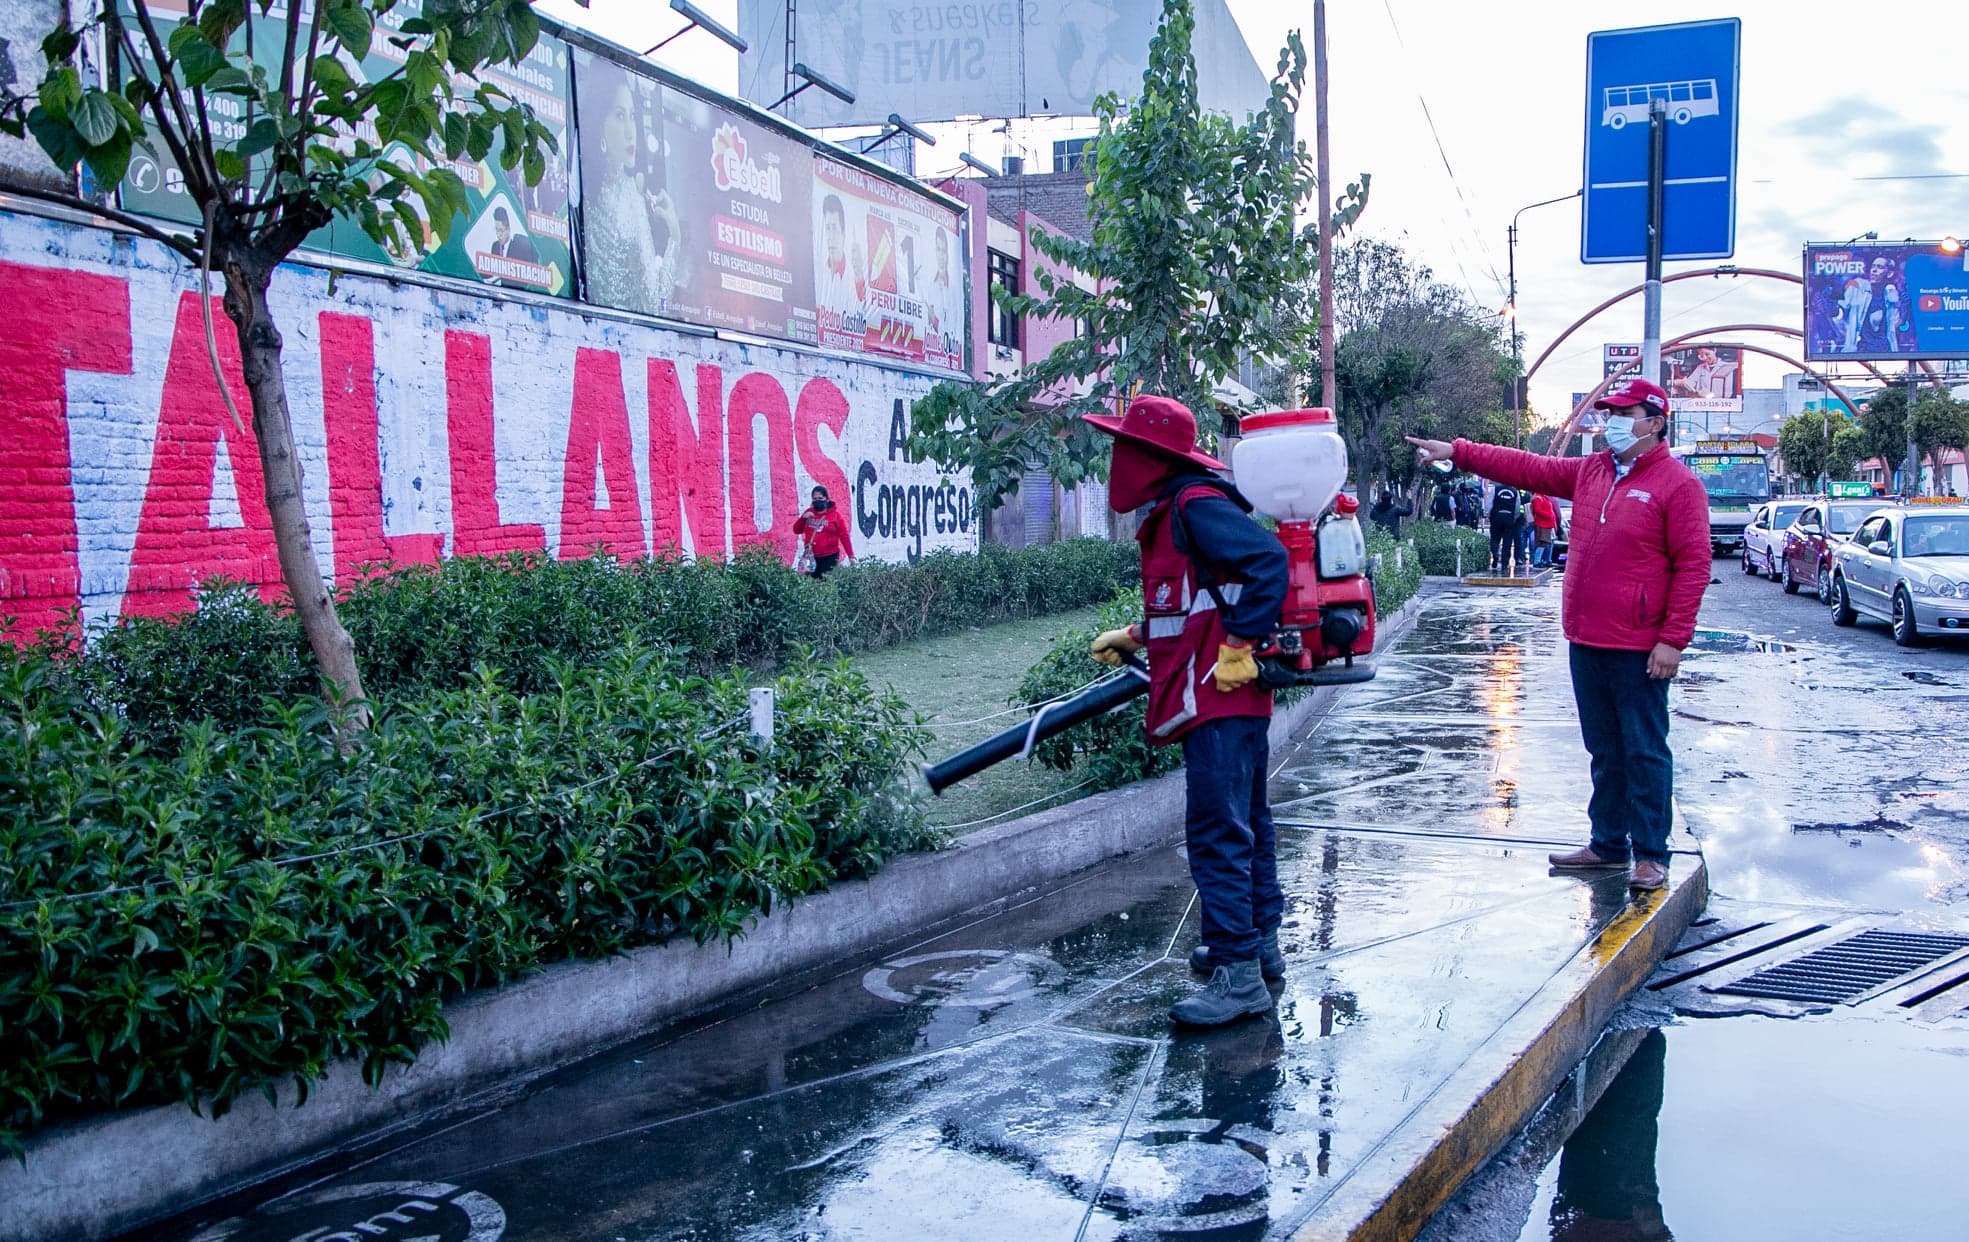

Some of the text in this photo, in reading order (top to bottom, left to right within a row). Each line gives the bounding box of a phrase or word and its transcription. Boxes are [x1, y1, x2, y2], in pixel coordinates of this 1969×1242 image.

[845, 168, 866, 189] UNA
[867, 177, 897, 203] NUEVA
[530, 214, 568, 239] TURISMO
[730, 199, 769, 226] ESTUDIA
[717, 221, 783, 259] ESTILISMO
[720, 253, 730, 268] UN
[1815, 261, 1865, 275] POWER
[820, 305, 841, 330] Pedro
[841, 310, 867, 336] Castillo
[898, 298, 923, 320] LIBRE
[0, 264, 853, 648] TALLANOS
[856, 460, 970, 566] Congreso
